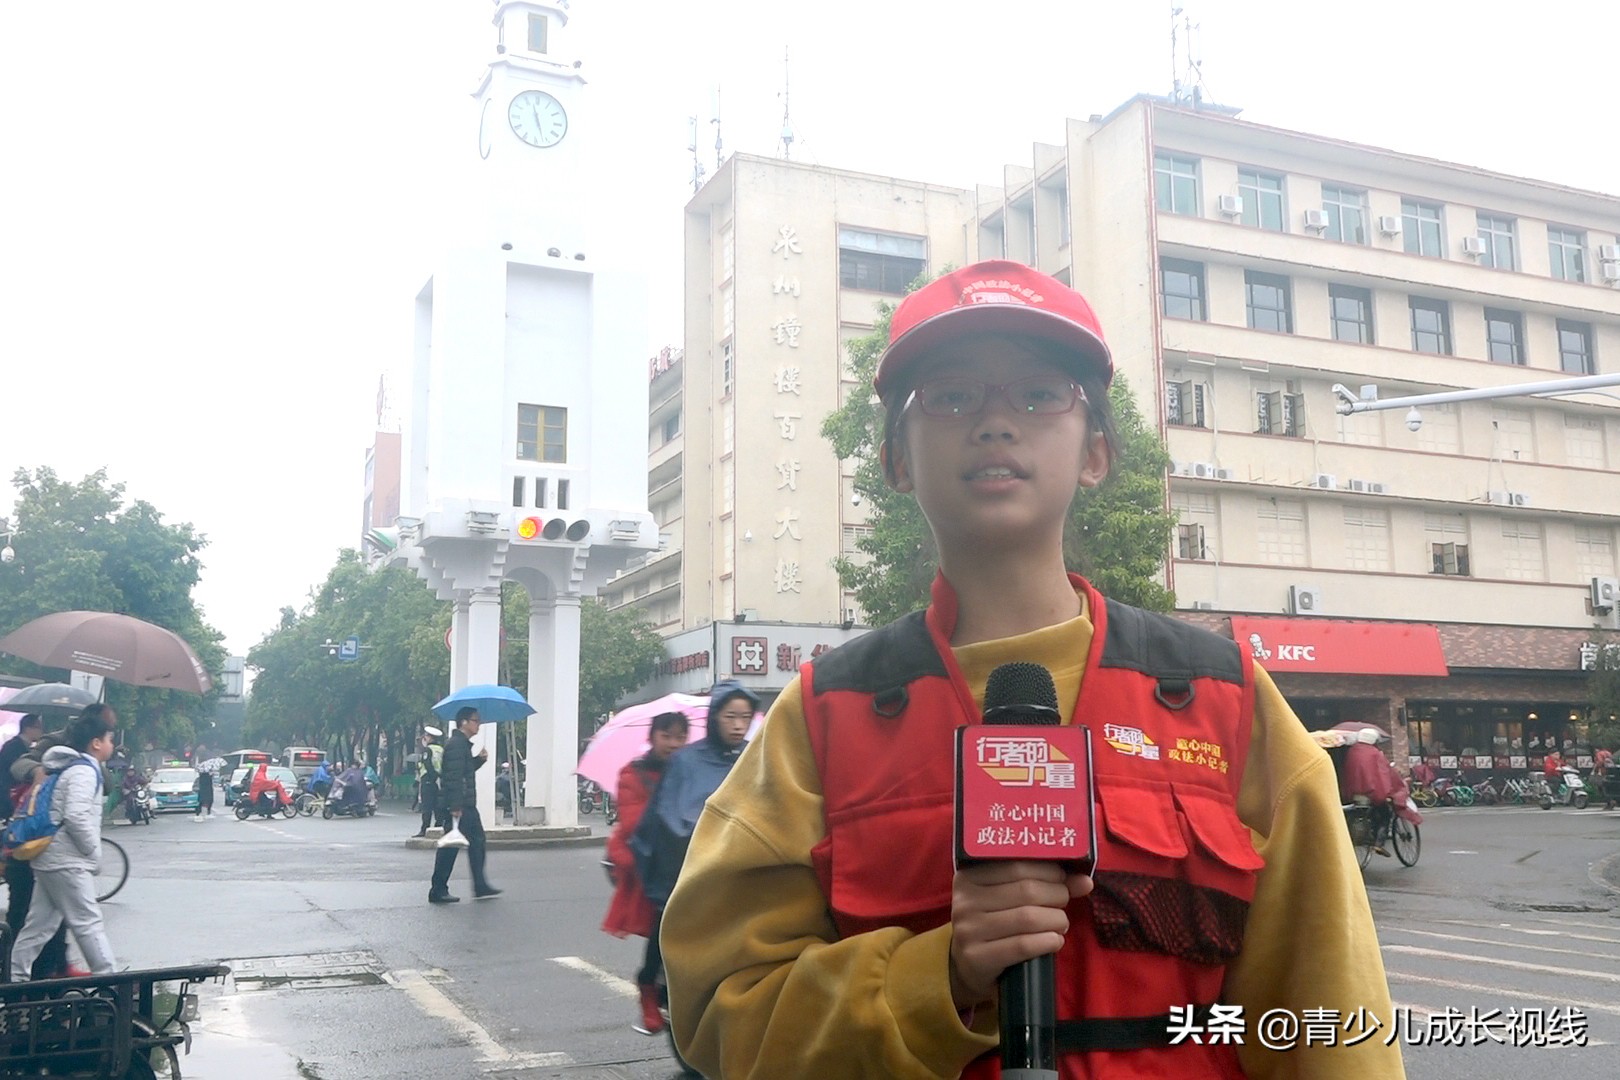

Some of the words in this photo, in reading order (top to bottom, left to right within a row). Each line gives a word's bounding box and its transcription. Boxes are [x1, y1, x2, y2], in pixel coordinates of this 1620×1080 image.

[1277, 644, 1316, 661] KFC
[976, 737, 1048, 767] 行者的
[1176, 738, 1221, 758] 童心中国
[1168, 749, 1229, 774] 政法小记者
[989, 802, 1065, 823] 童心中国
[977, 826, 1077, 847] 政法小记者
